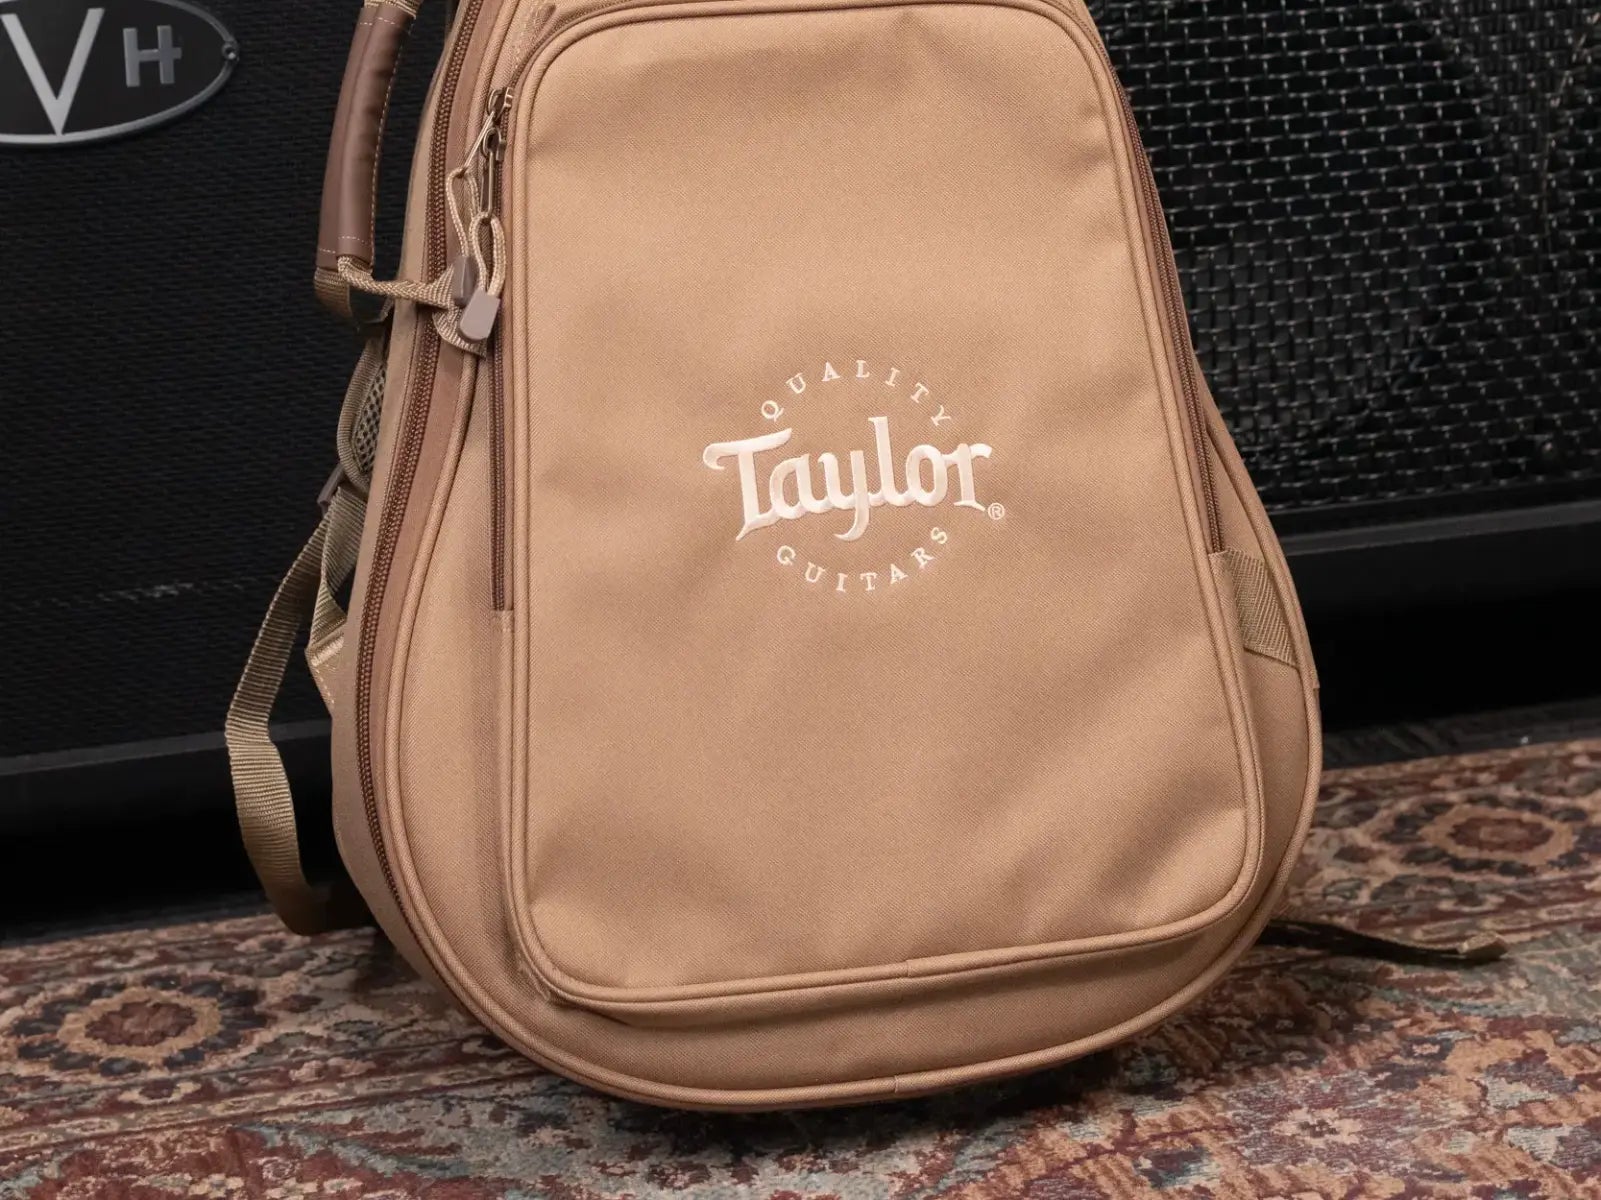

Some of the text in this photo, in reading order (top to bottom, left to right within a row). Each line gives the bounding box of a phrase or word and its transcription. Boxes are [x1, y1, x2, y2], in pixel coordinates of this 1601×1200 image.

[760, 359, 951, 427] QUALITY
[702, 415, 993, 542] Taylor
[776, 527, 949, 593] GUITARS
